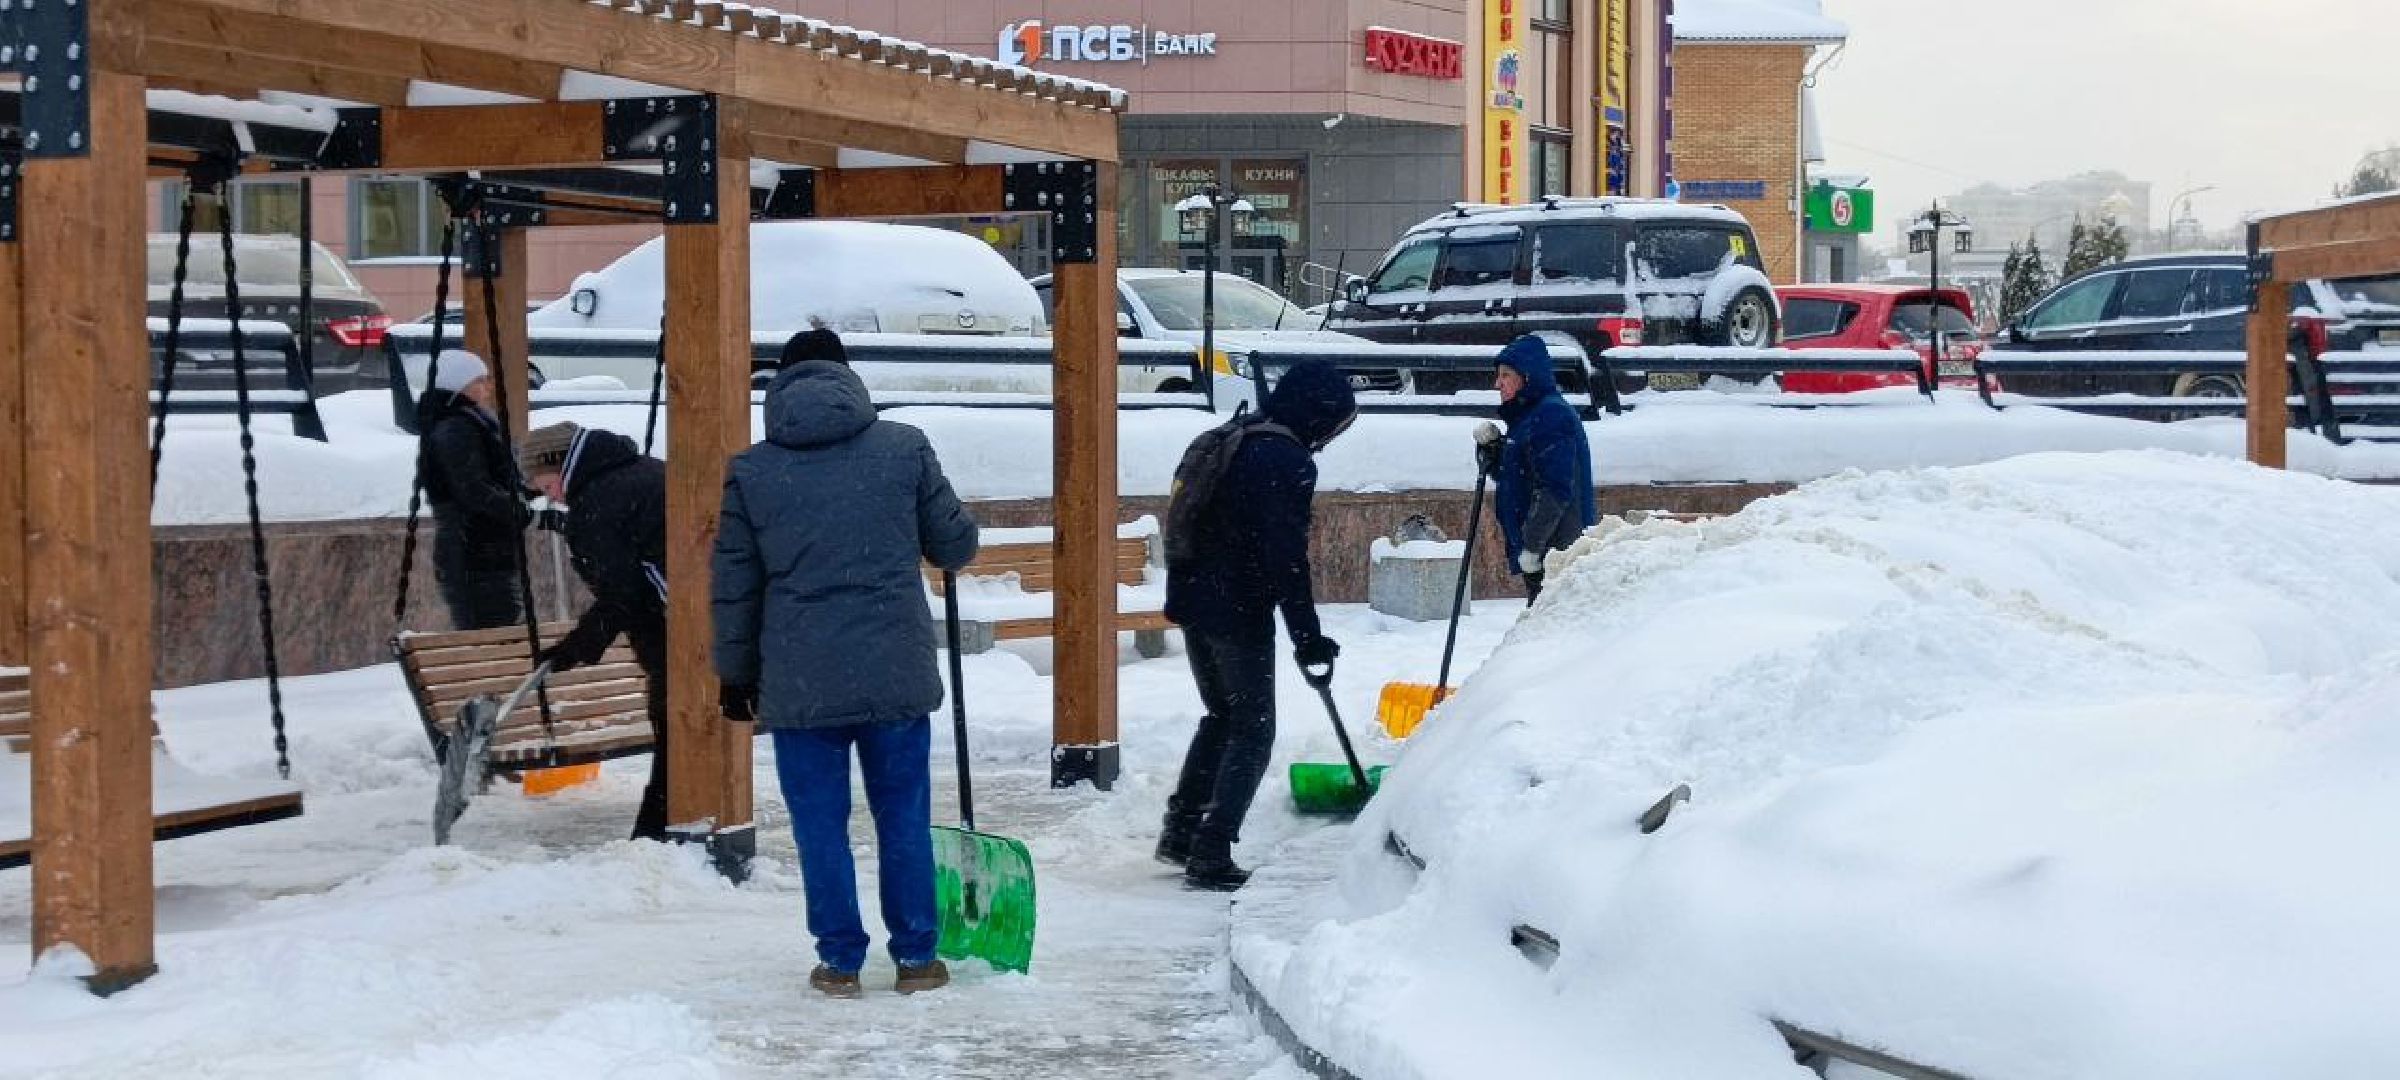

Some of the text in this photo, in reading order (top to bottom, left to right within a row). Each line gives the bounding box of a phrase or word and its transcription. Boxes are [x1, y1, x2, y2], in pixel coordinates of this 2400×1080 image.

[1052, 25, 1216, 61] ПСБ БАНК
[1375, 33, 1463, 80] КУХНИ
[1245, 169, 1294, 181] КУХНИ
[224, 304, 300, 316] ADA
